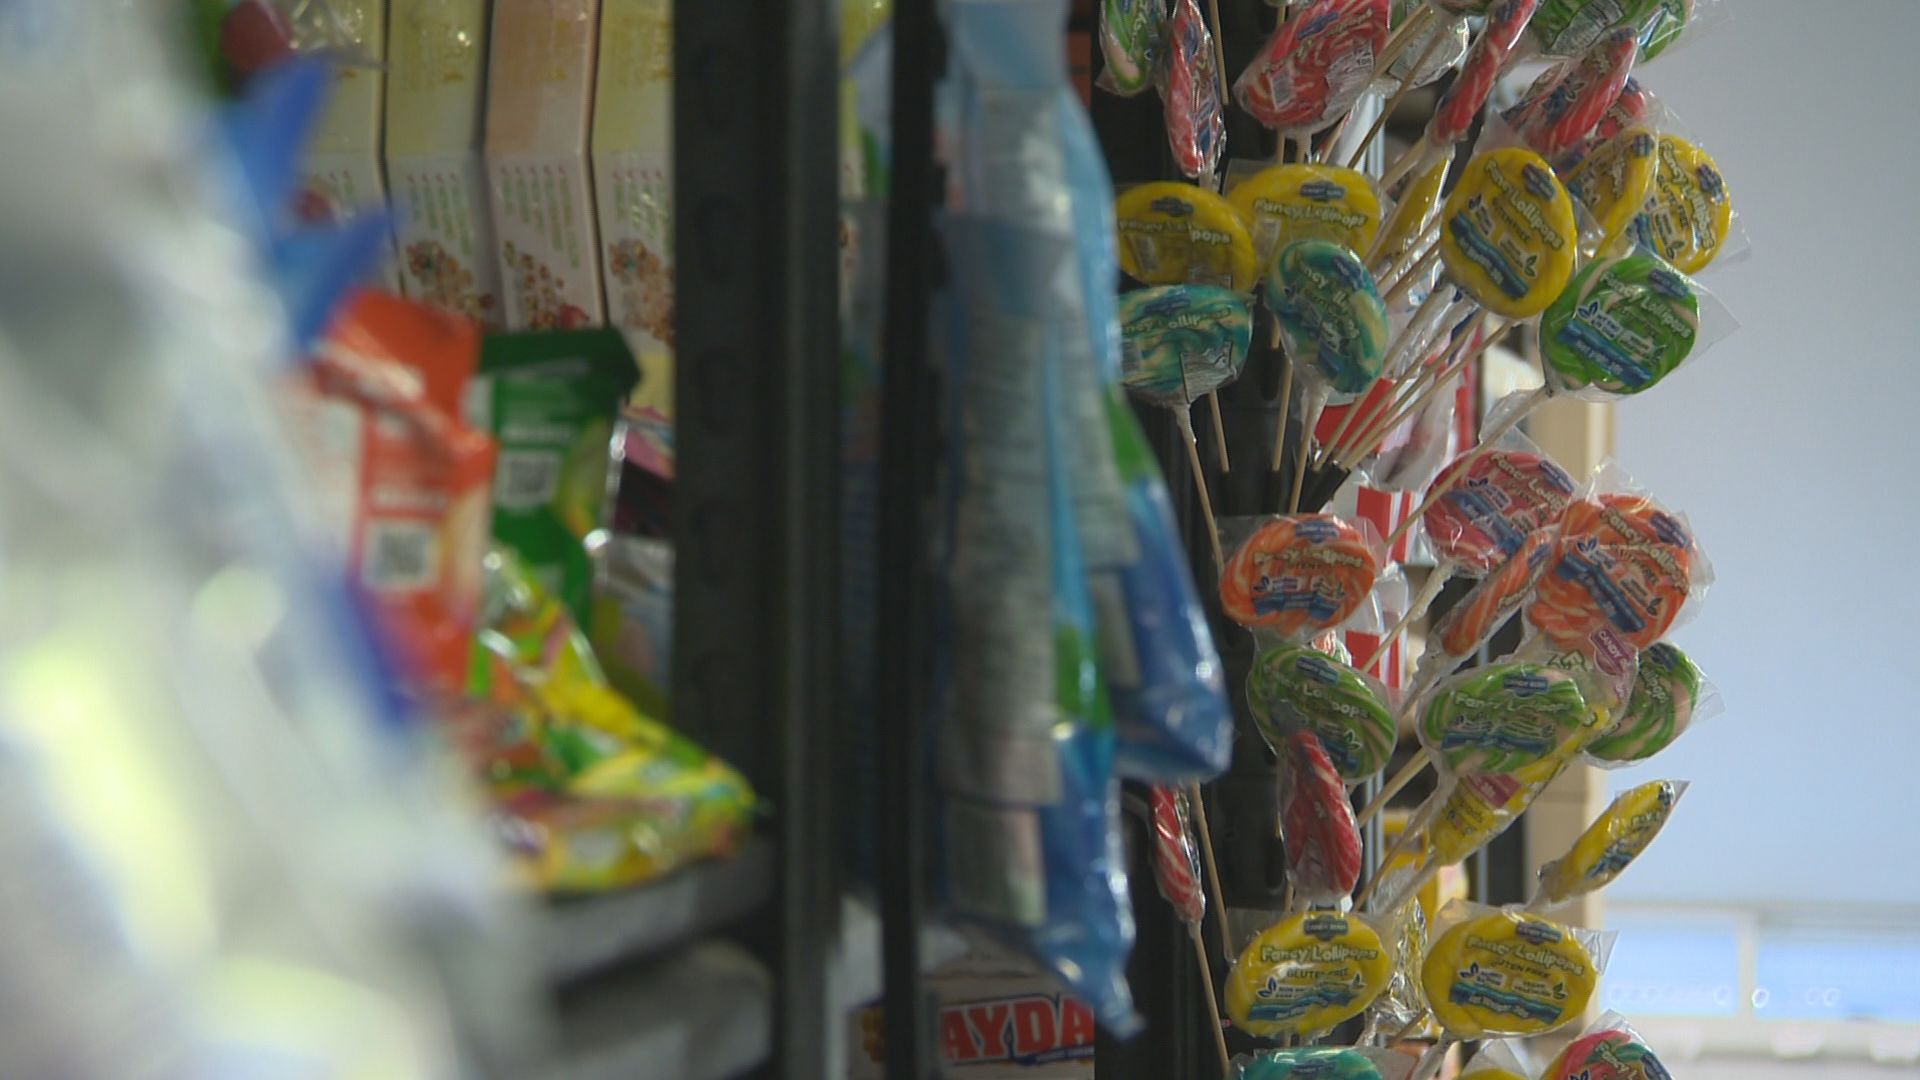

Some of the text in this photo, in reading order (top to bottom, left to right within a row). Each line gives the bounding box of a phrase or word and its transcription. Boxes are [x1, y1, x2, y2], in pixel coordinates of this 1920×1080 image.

[1510, 193, 1564, 249] Lollipops
[1641, 295, 1691, 339] Lollipops
[1601, 508, 1641, 547] Fancy
[1598, 630, 1622, 658] CANDY
[1261, 945, 1378, 963] Fancy Lollipops
[1513, 944, 1584, 976] Lollipops
[942, 996, 1095, 1060] AYDA
